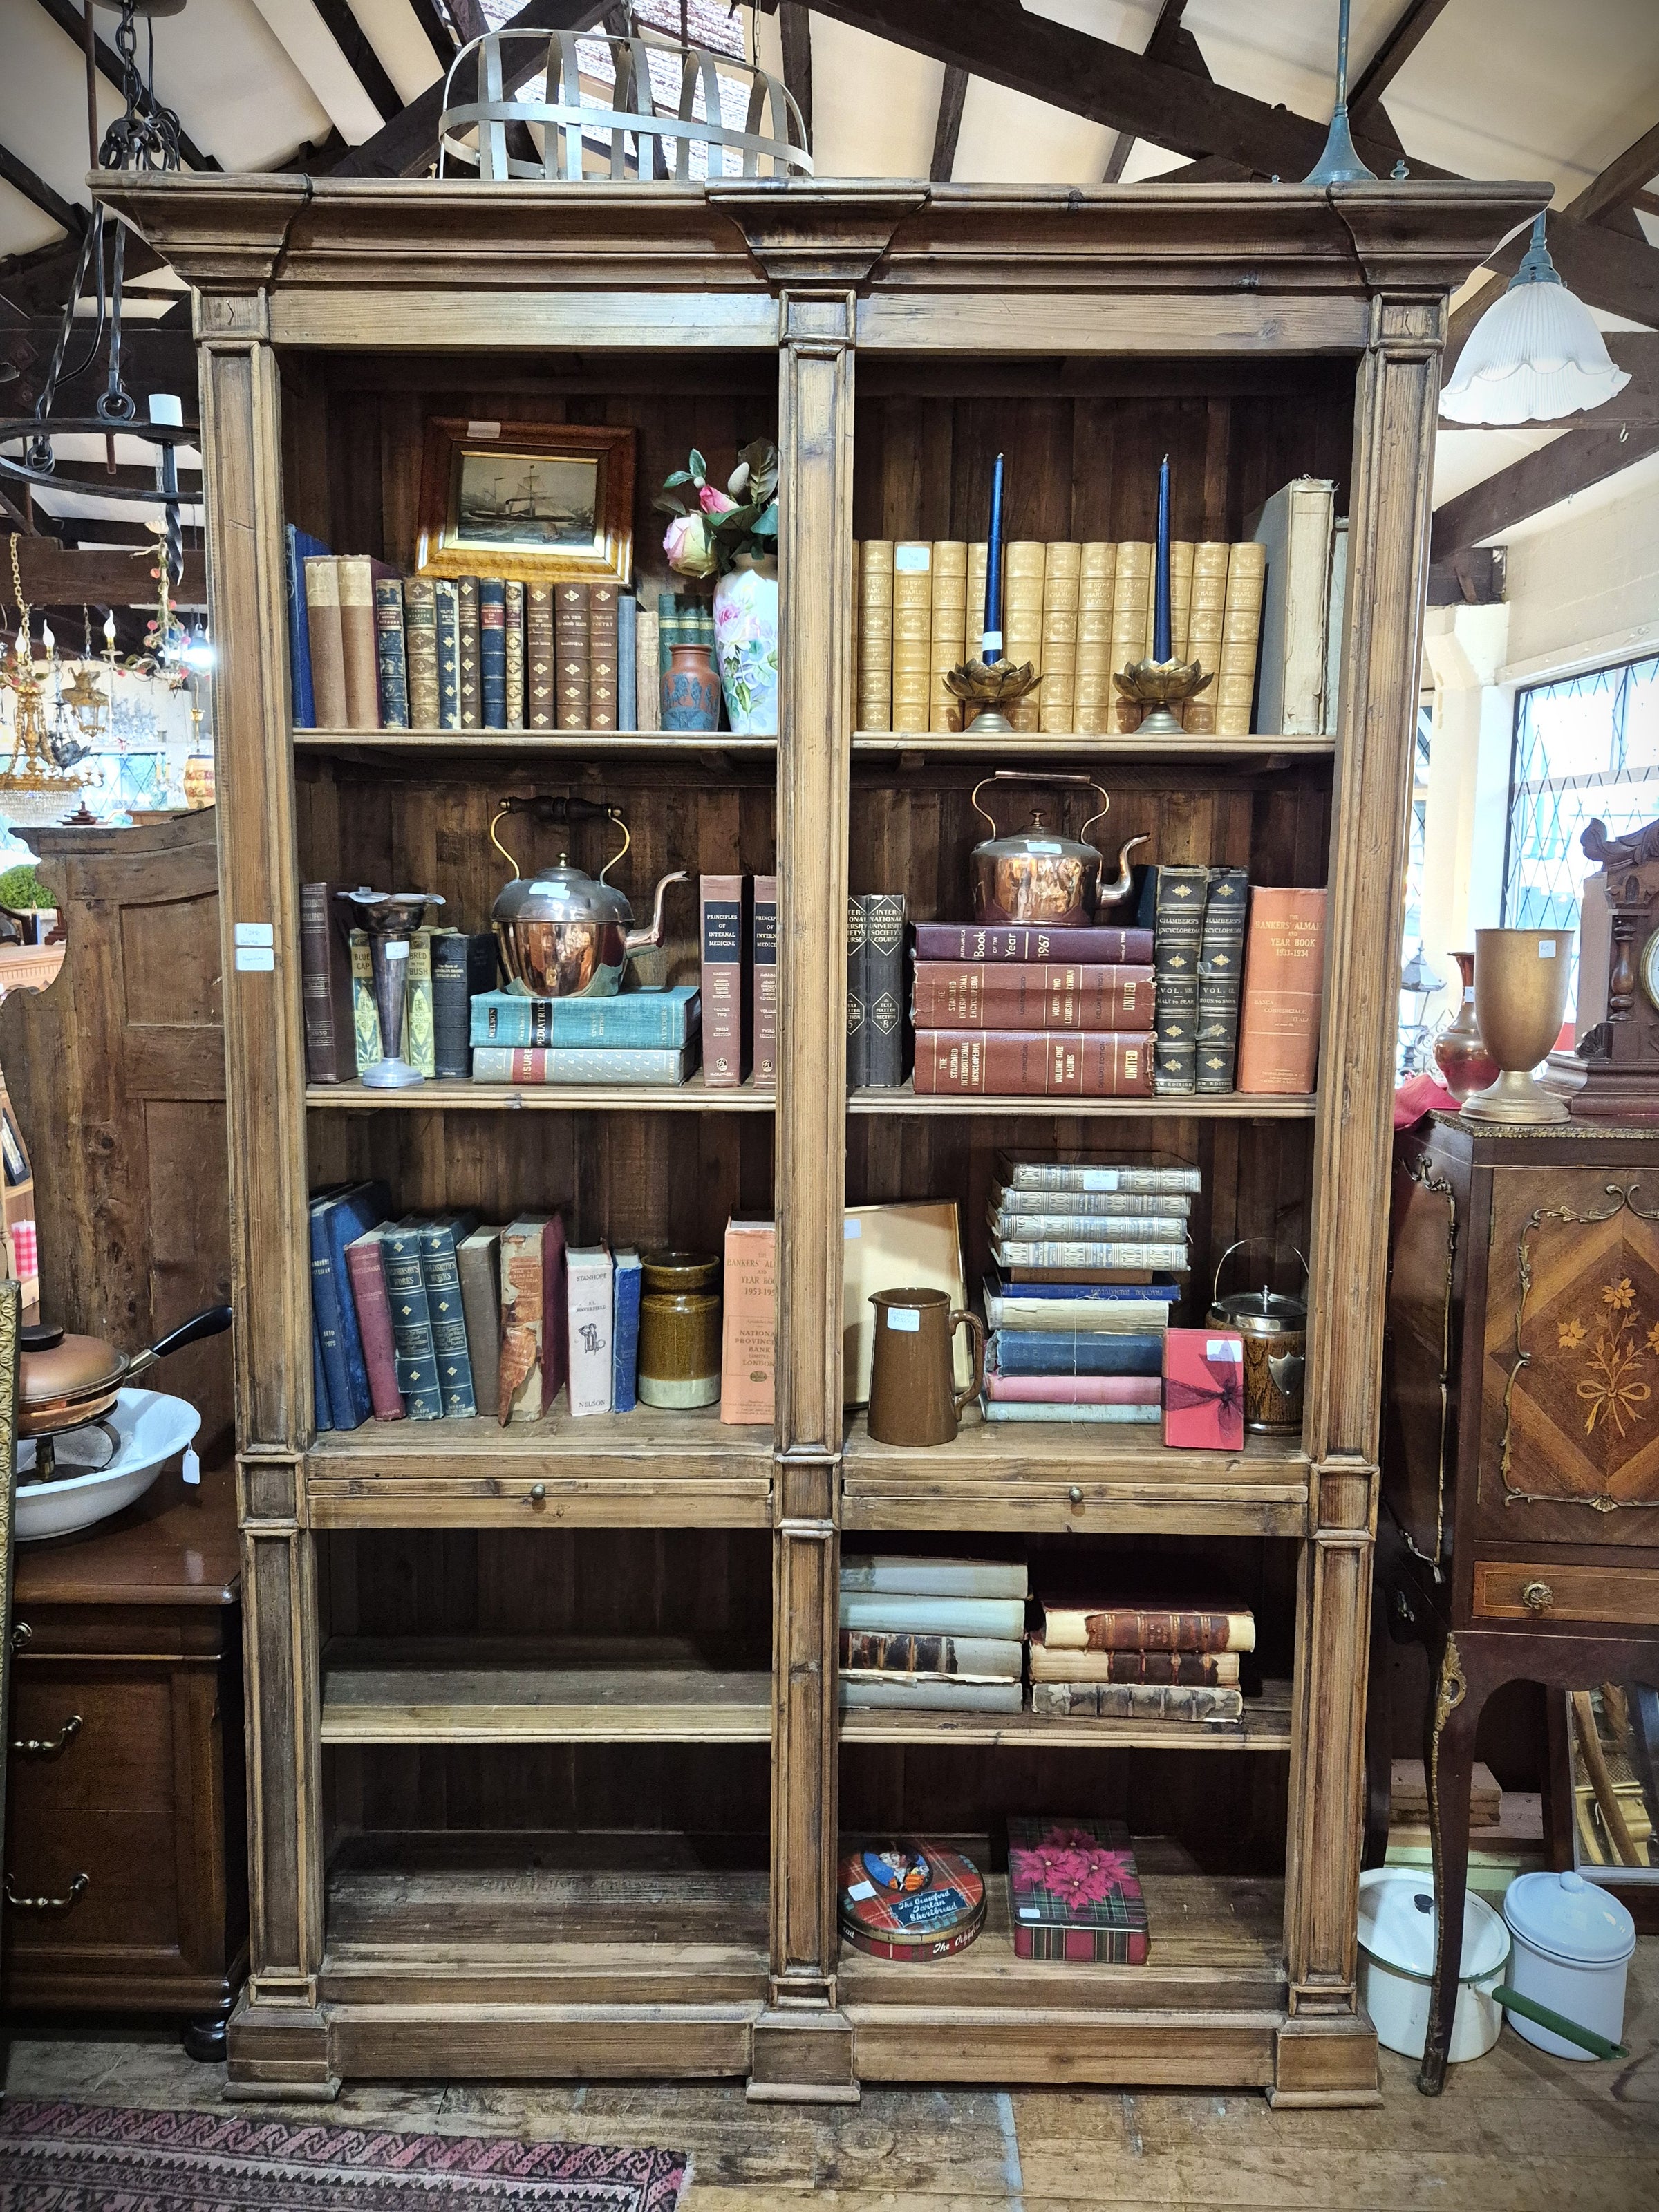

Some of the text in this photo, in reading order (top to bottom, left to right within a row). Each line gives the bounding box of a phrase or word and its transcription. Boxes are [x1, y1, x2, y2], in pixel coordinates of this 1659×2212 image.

[1255, 921, 1292, 930] BANKERS'
[973, 930, 986, 958] Book
[1004, 933, 1017, 957] Year
[1038, 934, 1050, 958] 1967
[1271, 937, 1316, 947] YEAR BOOK
[1276, 948, 1309, 957] 1933-1934
[357, 962, 370, 971] CAP
[409, 952, 427, 961] BRED
[409, 968, 429, 976] BUSH
[948, 980, 957, 1011] STANDARD
[959, 974, 968, 1019] INTERNATIONAL
[969, 975, 979, 1018] ENCYCLOPEDIA
[1122, 982, 1136, 1011] UNITED
[536, 999, 547, 1047] PEDIATRICS
[883, 1020, 889, 1029] 8
[939, 1057, 948, 1070] THE
[950, 1048, 959, 1079] STANDARD
[960, 1041, 970, 1086] INTERNATIONAL
[971, 1042, 980, 1086] ENCYCLOPEDIA
[1055, 1045, 1064, 1083] VOLUME ONE
[1125, 1050, 1138, 1079] UNITED
[576, 1273, 607, 1282] STANHOPE
[741, 1276, 760, 1284] YEAR
[579, 1400, 606, 1408] NELSON
[898, 1889, 951, 1911] The Crawford
[913, 1900, 946, 1913] Tartan
[910, 1902, 958, 1922] Shortbread
[932, 1942, 950, 1954] The
